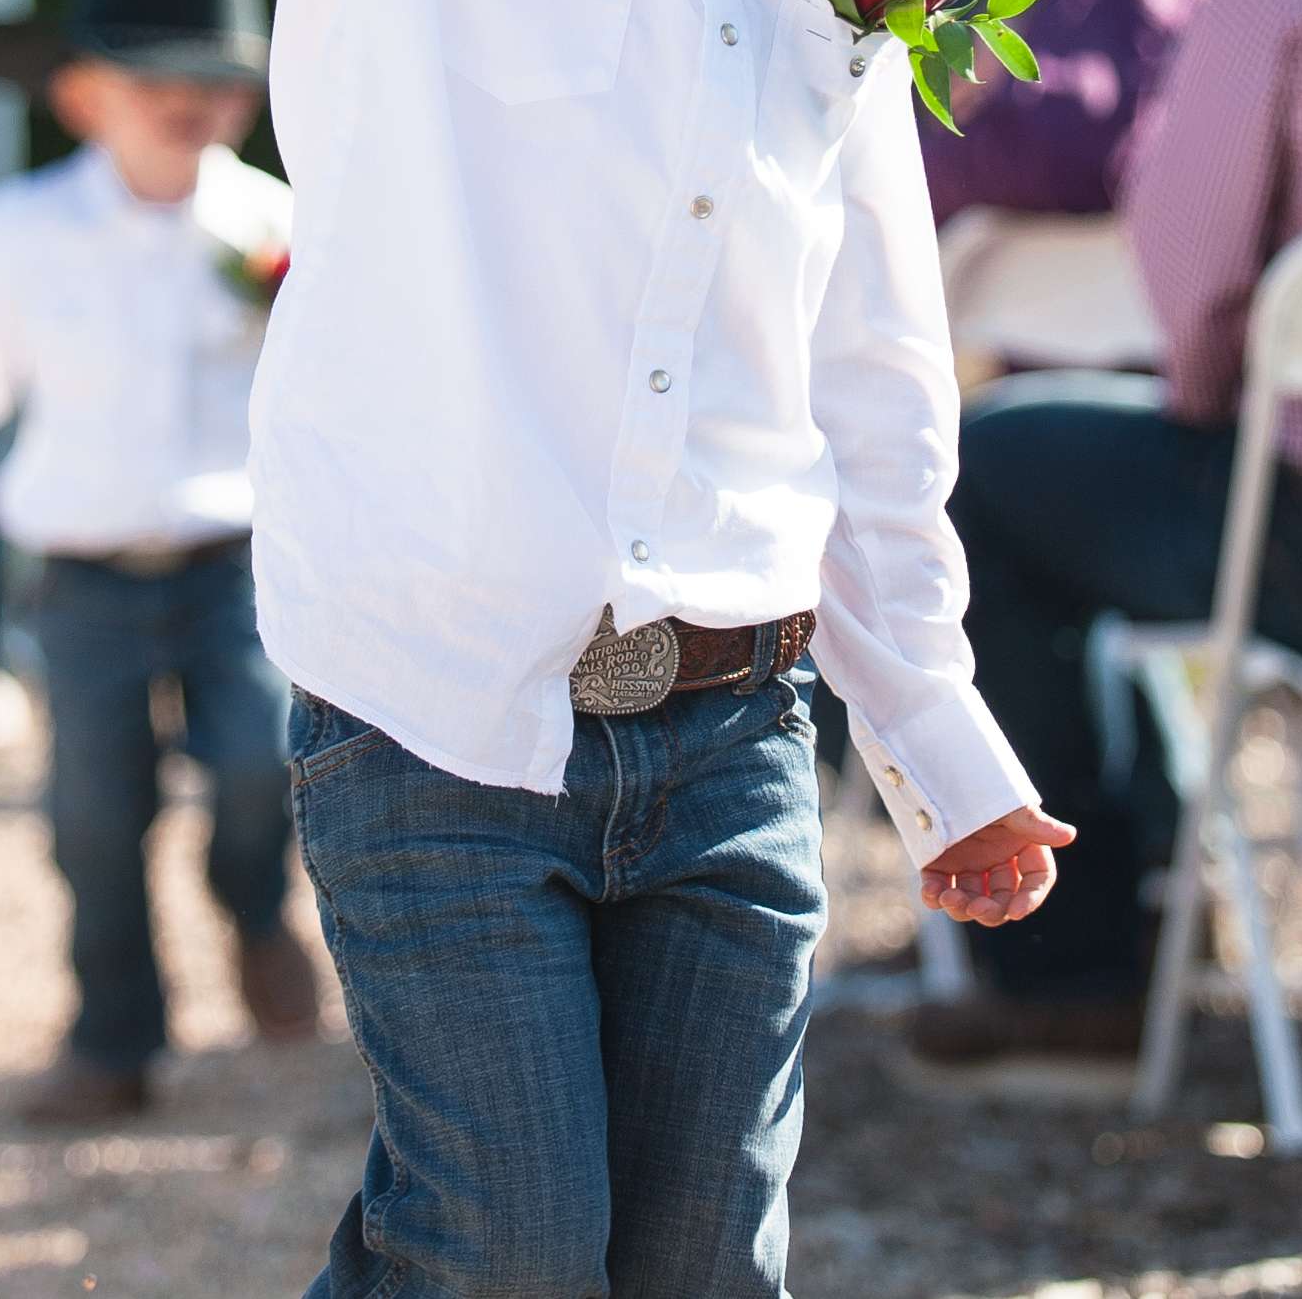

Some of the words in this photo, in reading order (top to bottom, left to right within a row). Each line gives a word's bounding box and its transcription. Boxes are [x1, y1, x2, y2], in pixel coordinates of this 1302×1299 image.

[581, 640, 636, 662] NATIONAL
[606, 651, 648, 669] RODEO
[612, 679, 663, 692] HESSTON
